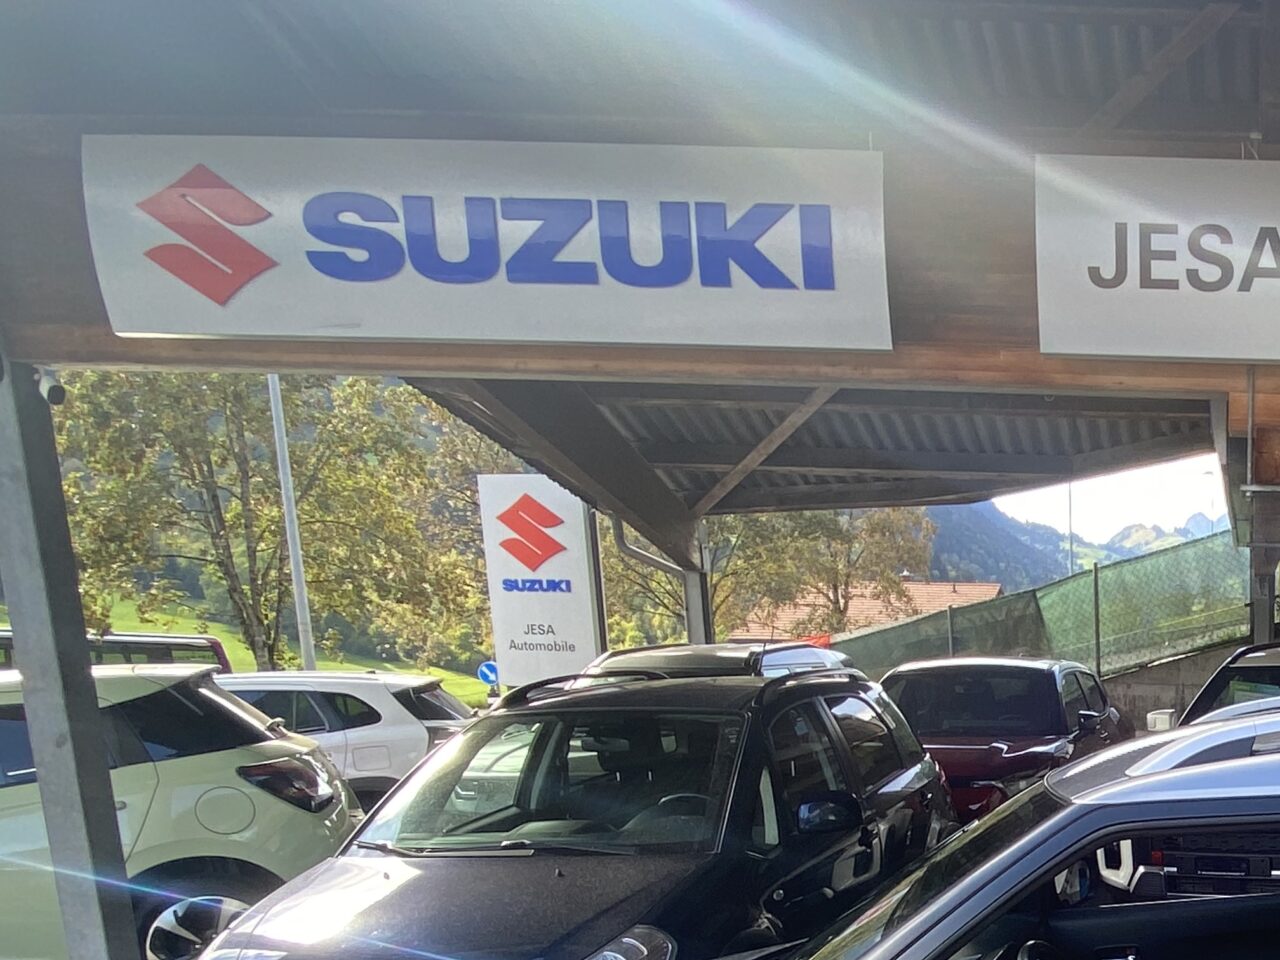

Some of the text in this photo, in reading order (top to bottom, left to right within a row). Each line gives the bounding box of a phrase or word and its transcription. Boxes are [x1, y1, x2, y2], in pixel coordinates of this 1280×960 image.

[304, 191, 835, 292] SUZUKI
[502, 578, 572, 593] SUZUKI
[523, 623, 556, 636] JESA
[508, 639, 576, 652] Automobile
